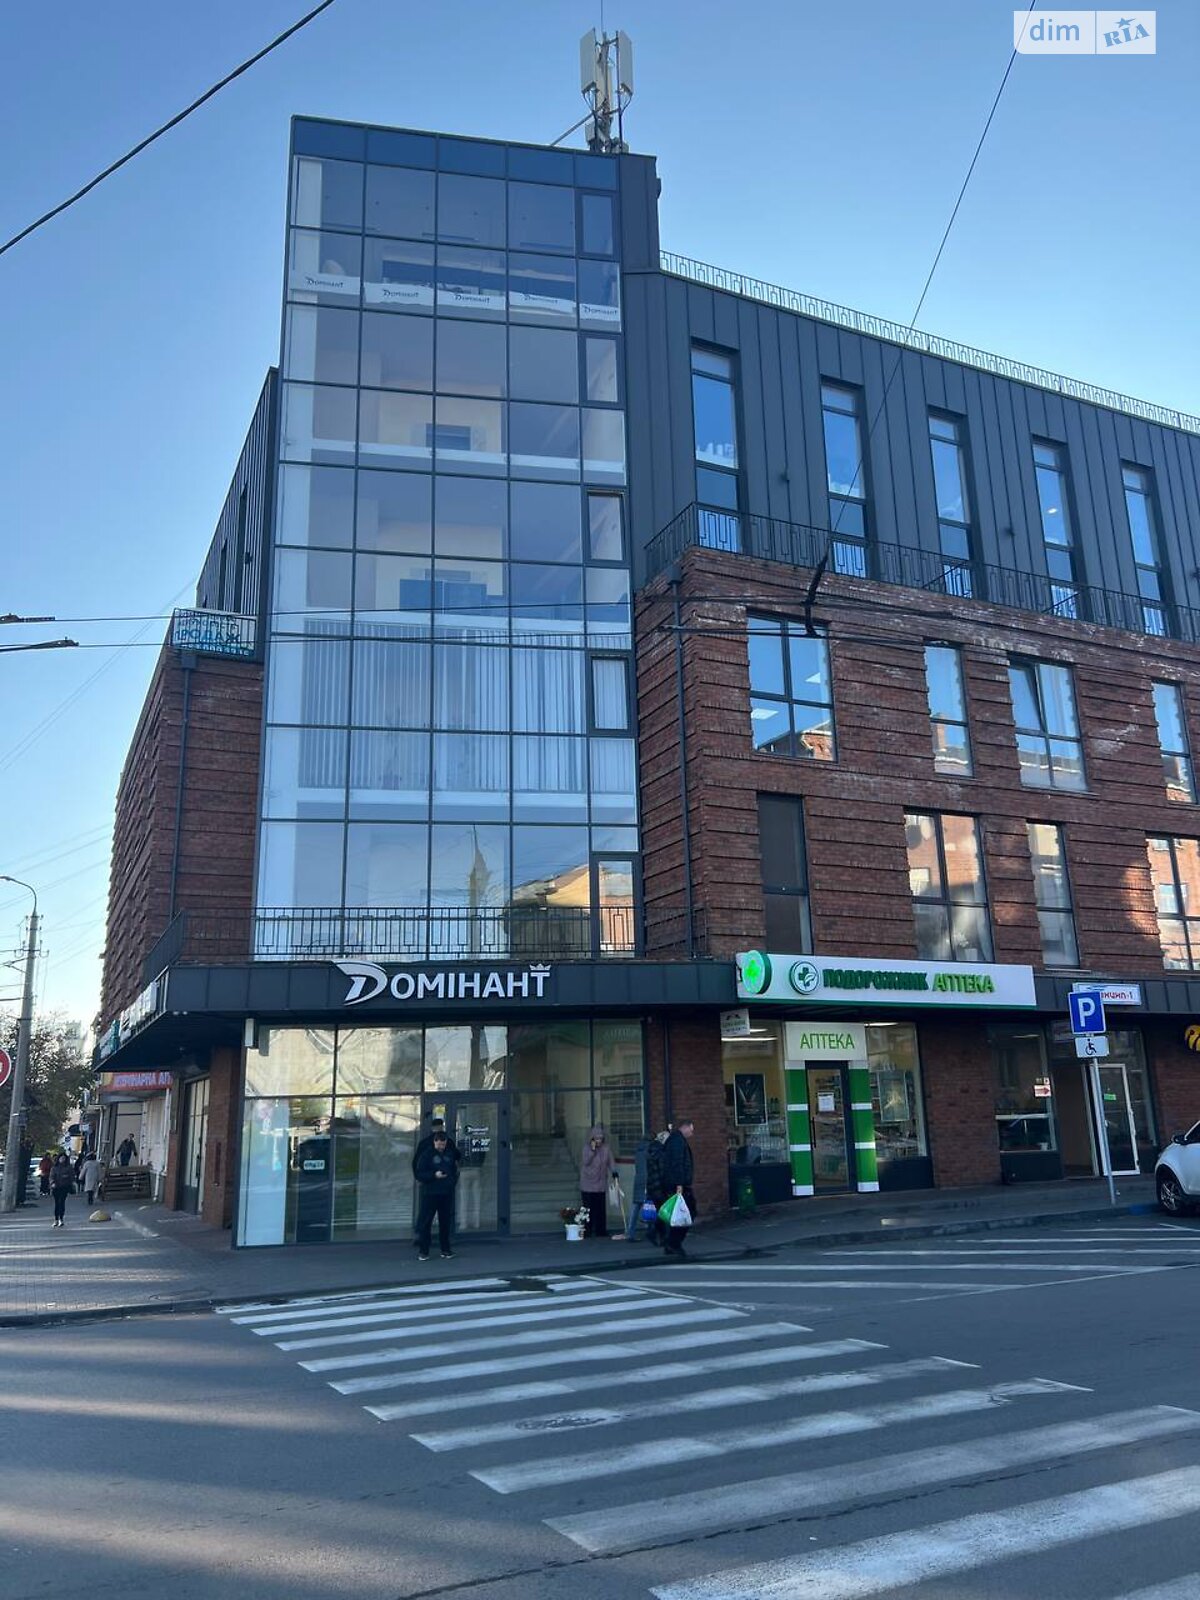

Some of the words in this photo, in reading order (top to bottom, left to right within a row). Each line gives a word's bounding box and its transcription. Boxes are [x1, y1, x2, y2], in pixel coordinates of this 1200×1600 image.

[822, 968, 930, 991] ПОДОРОЖНИК
[932, 973, 995, 994] АПТЕКА
[1077, 997, 1096, 1028] P
[800, 1032, 855, 1050] АПТЕКА
